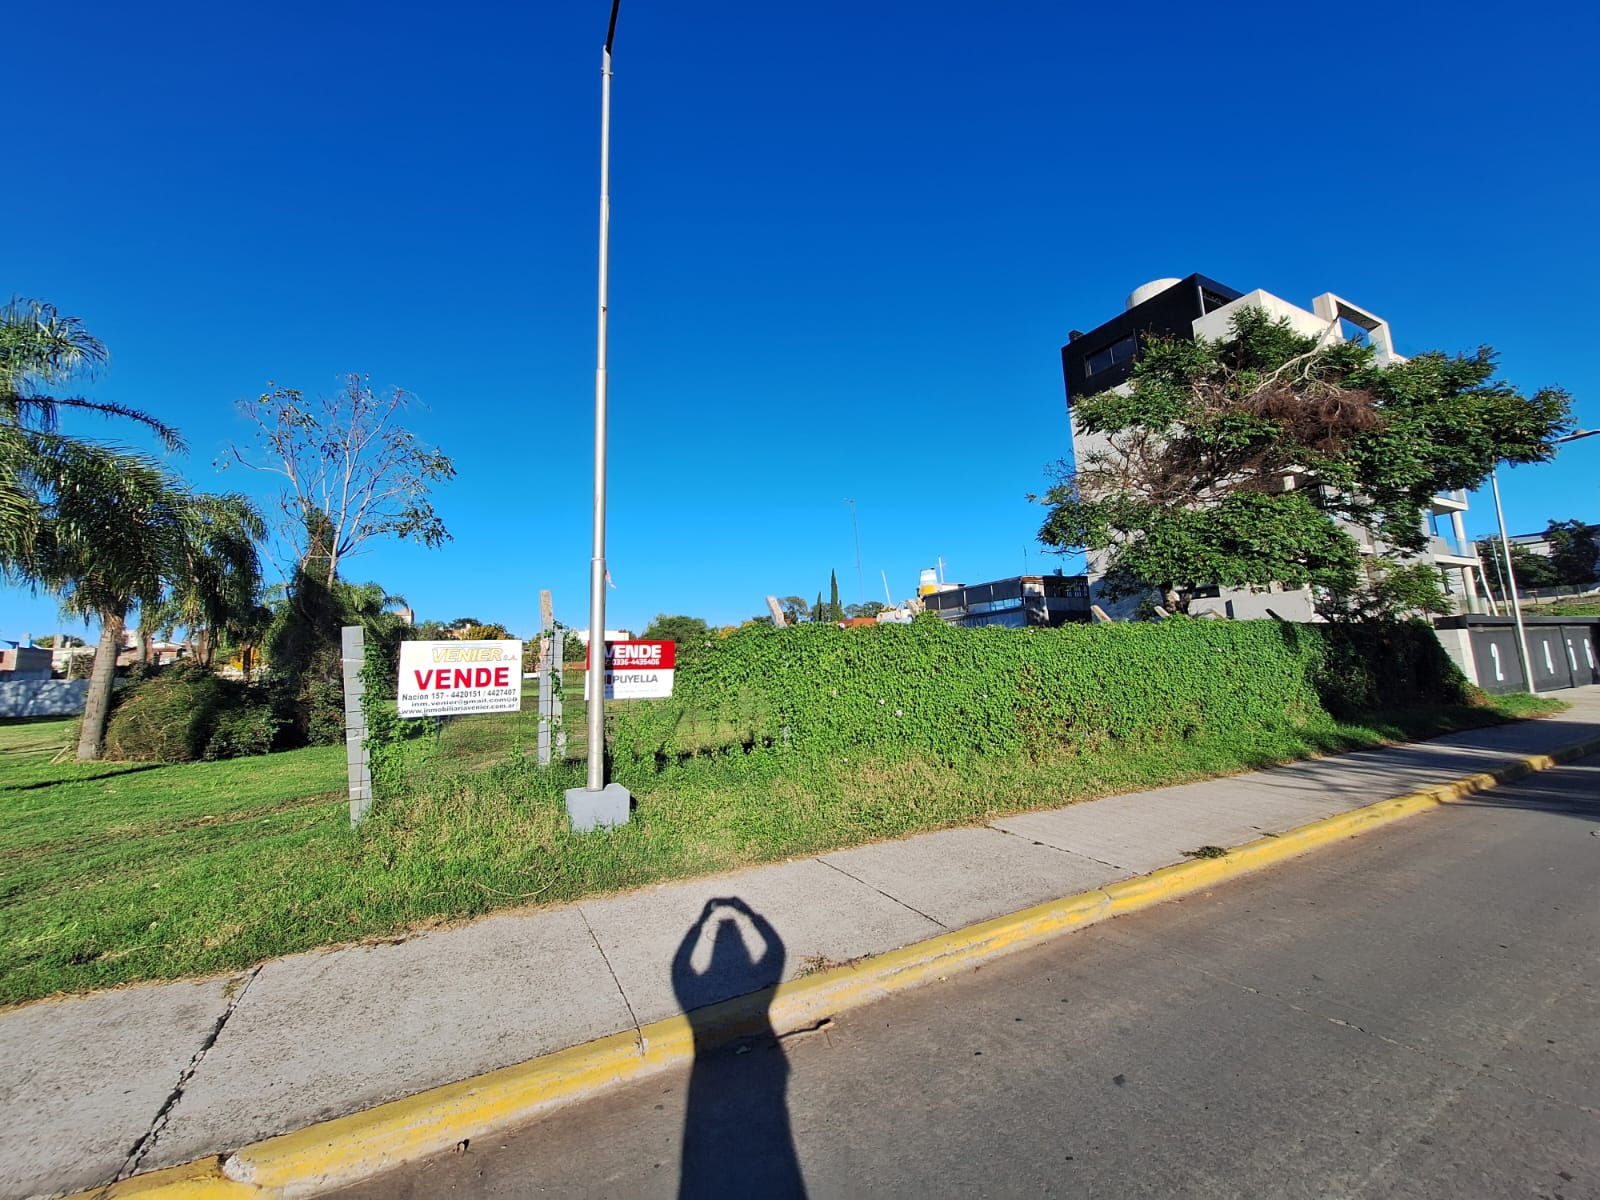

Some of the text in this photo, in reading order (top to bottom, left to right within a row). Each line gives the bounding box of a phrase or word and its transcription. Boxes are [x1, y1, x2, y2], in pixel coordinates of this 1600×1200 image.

[432, 647, 503, 663] VENIER
[605, 644, 662, 659] VENDE
[414, 667, 509, 690] VENDE
[431, 692, 444, 700] 157
[451, 690, 481, 698] 4420151
[487, 688, 516, 697] 4427407
